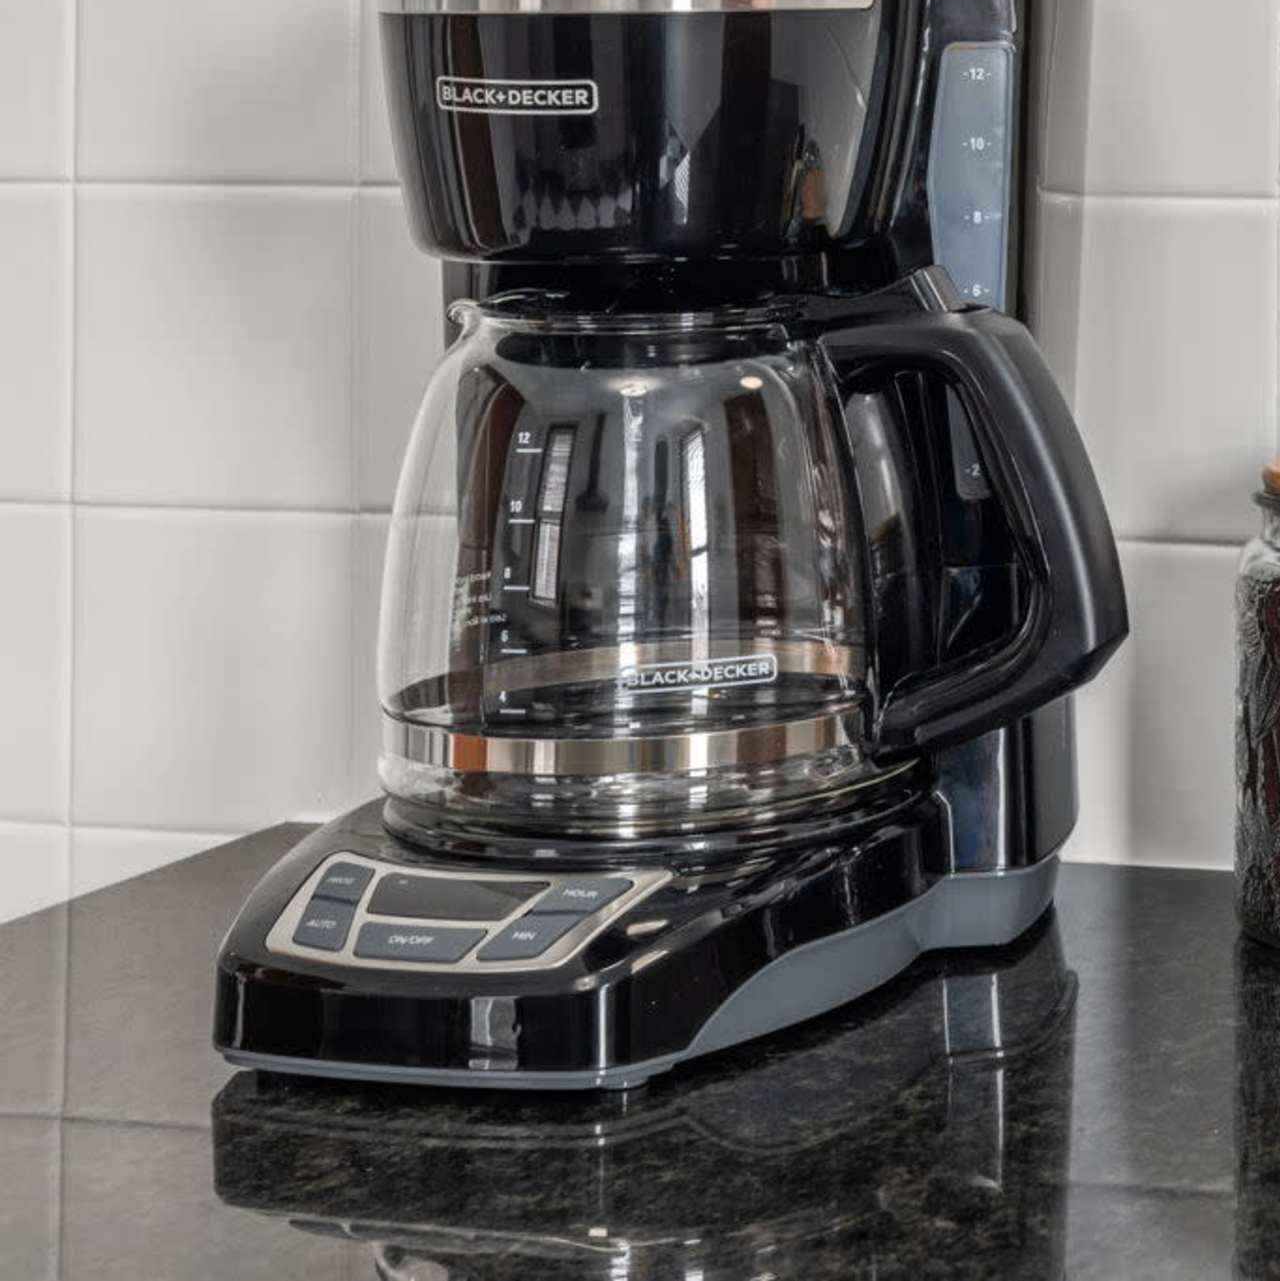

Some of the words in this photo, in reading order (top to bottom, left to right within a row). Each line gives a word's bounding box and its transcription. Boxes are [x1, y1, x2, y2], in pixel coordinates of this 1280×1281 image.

[441, 85, 589, 106] BLACK+DECKER
[518, 431, 531, 444] 12
[509, 499, 523, 513] 10
[627, 661, 771, 687] BLACK+DECKER
[561, 888, 599, 899] HOUR
[388, 935, 435, 946] ON/OFF
[511, 931, 537, 941] MIN
